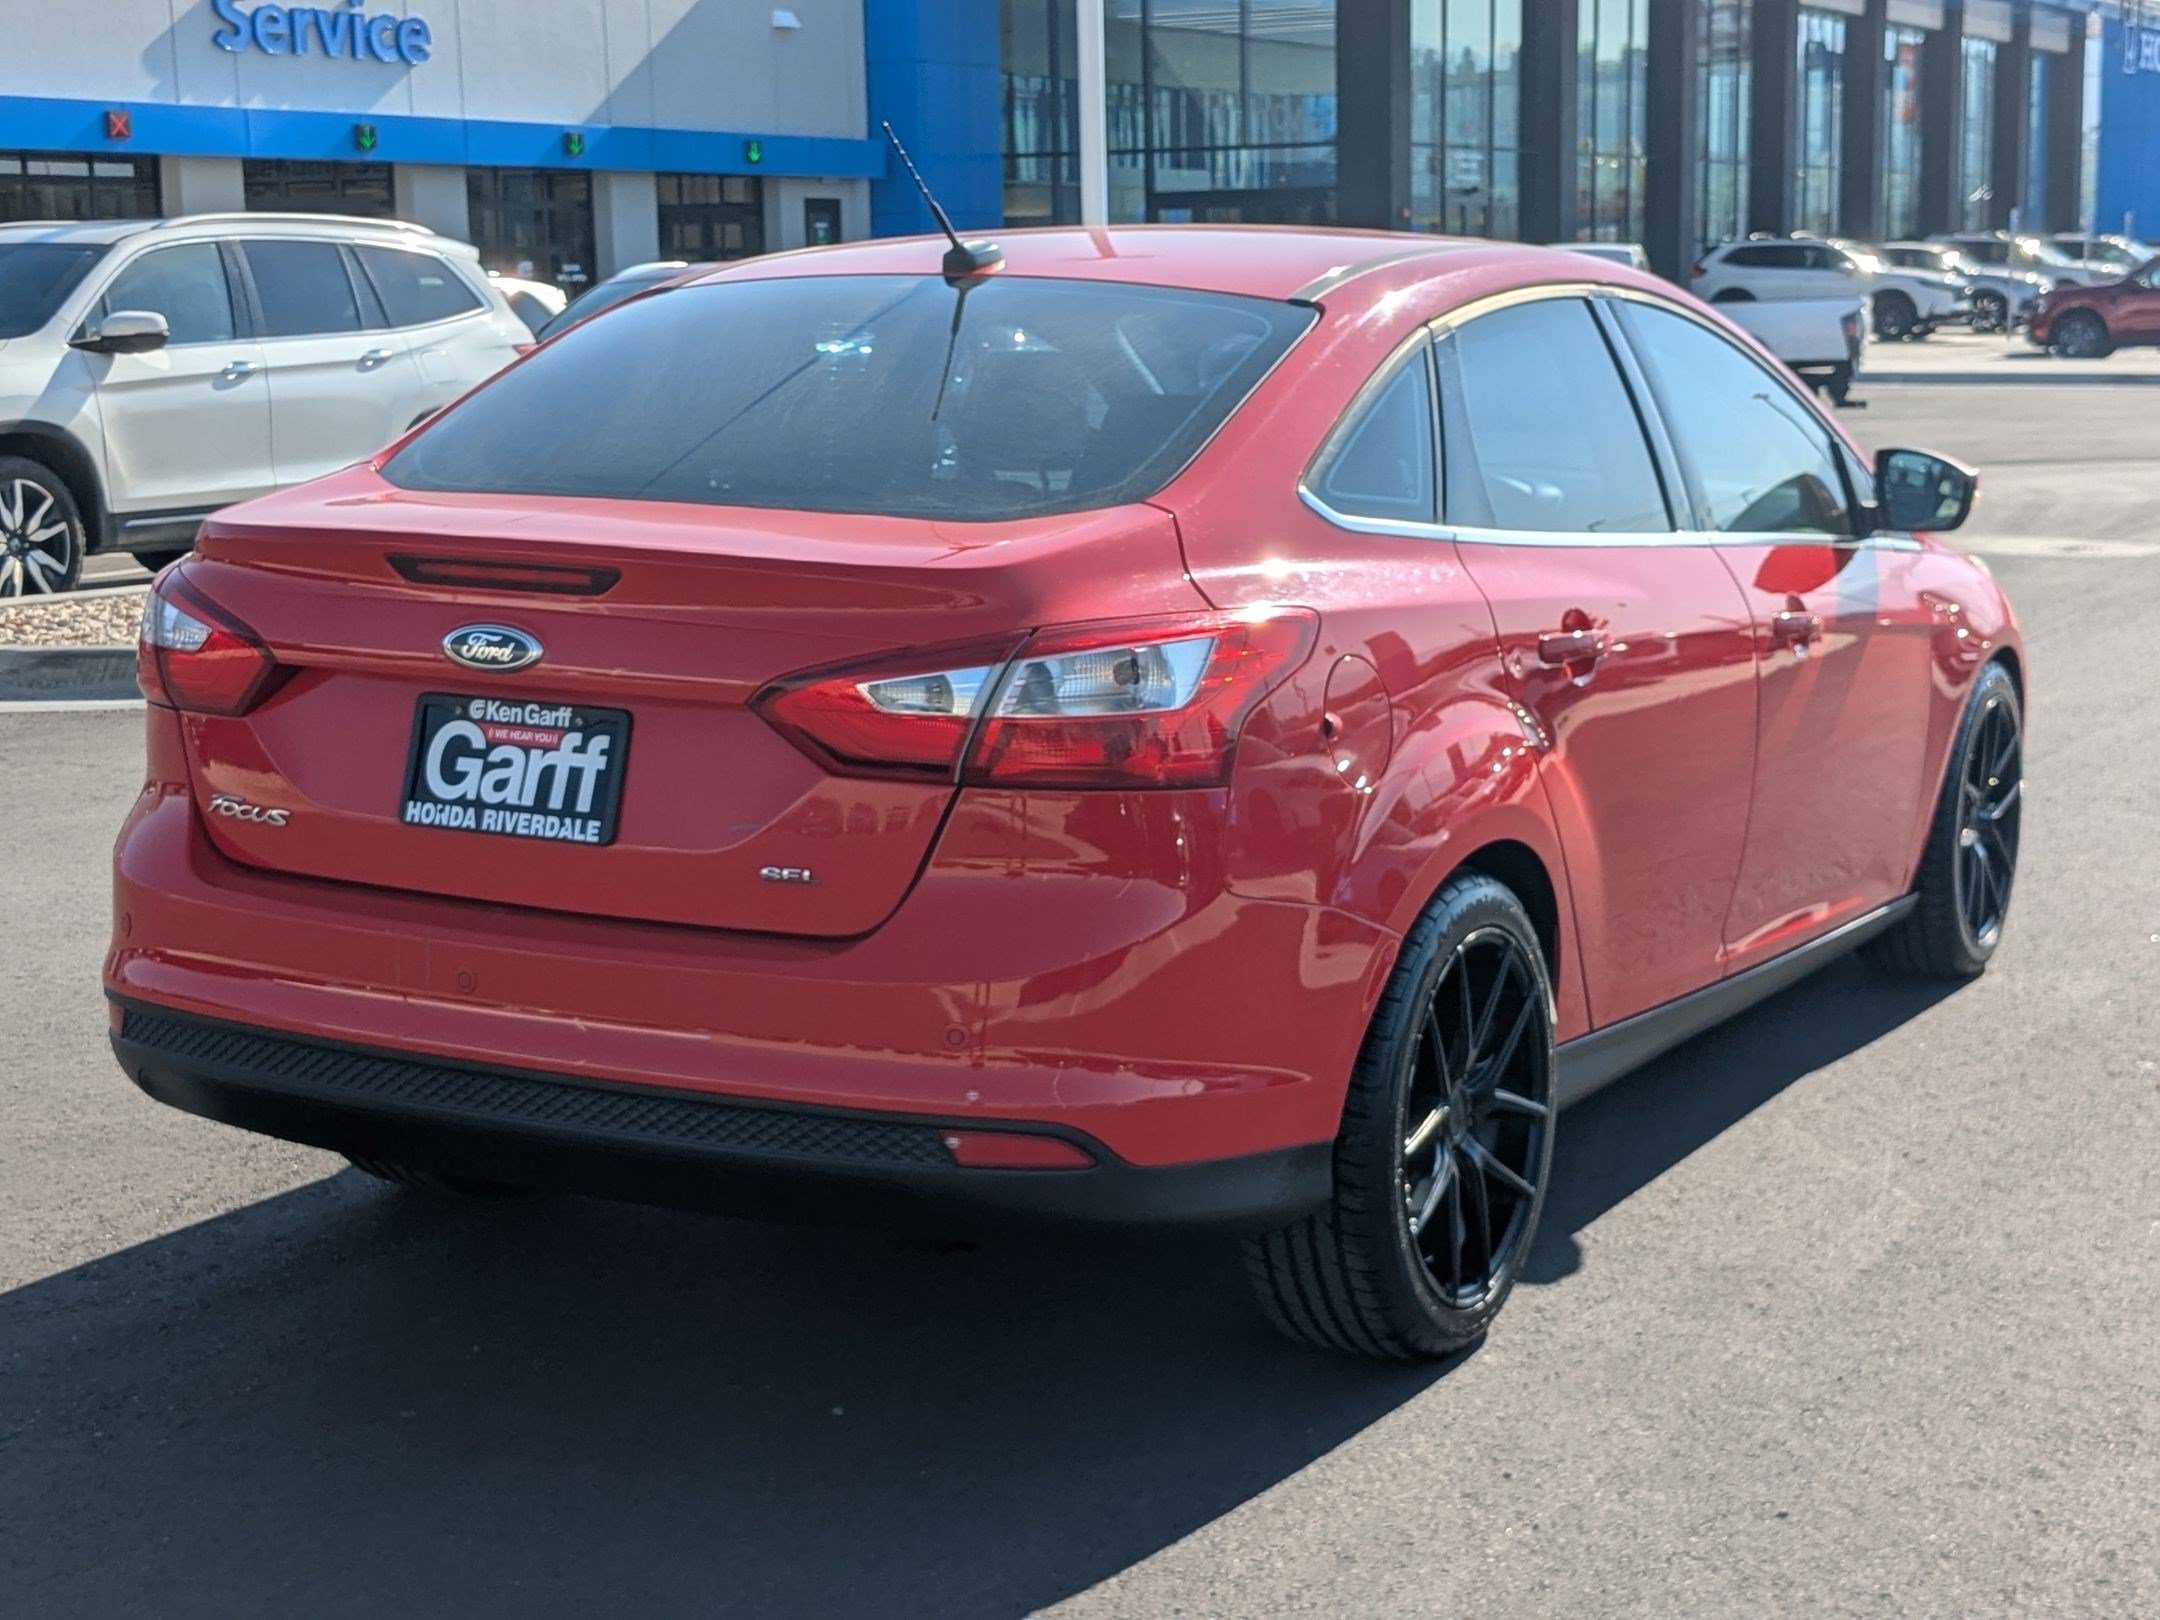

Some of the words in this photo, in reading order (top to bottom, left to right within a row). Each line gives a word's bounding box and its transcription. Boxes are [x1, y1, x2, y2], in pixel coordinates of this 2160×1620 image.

[212, 0, 433, 65] Service
[460, 632, 514, 663] Ford
[486, 700, 523, 723] Ken
[524, 703, 573, 728] Garff
[495, 729, 509, 739] WE
[510, 730, 534, 741] HEAR
[534, 732, 553, 743] YOU
[426, 719, 611, 814] Garff
[405, 800, 477, 829] HONDA
[480, 808, 602, 843] RIVERDALE
